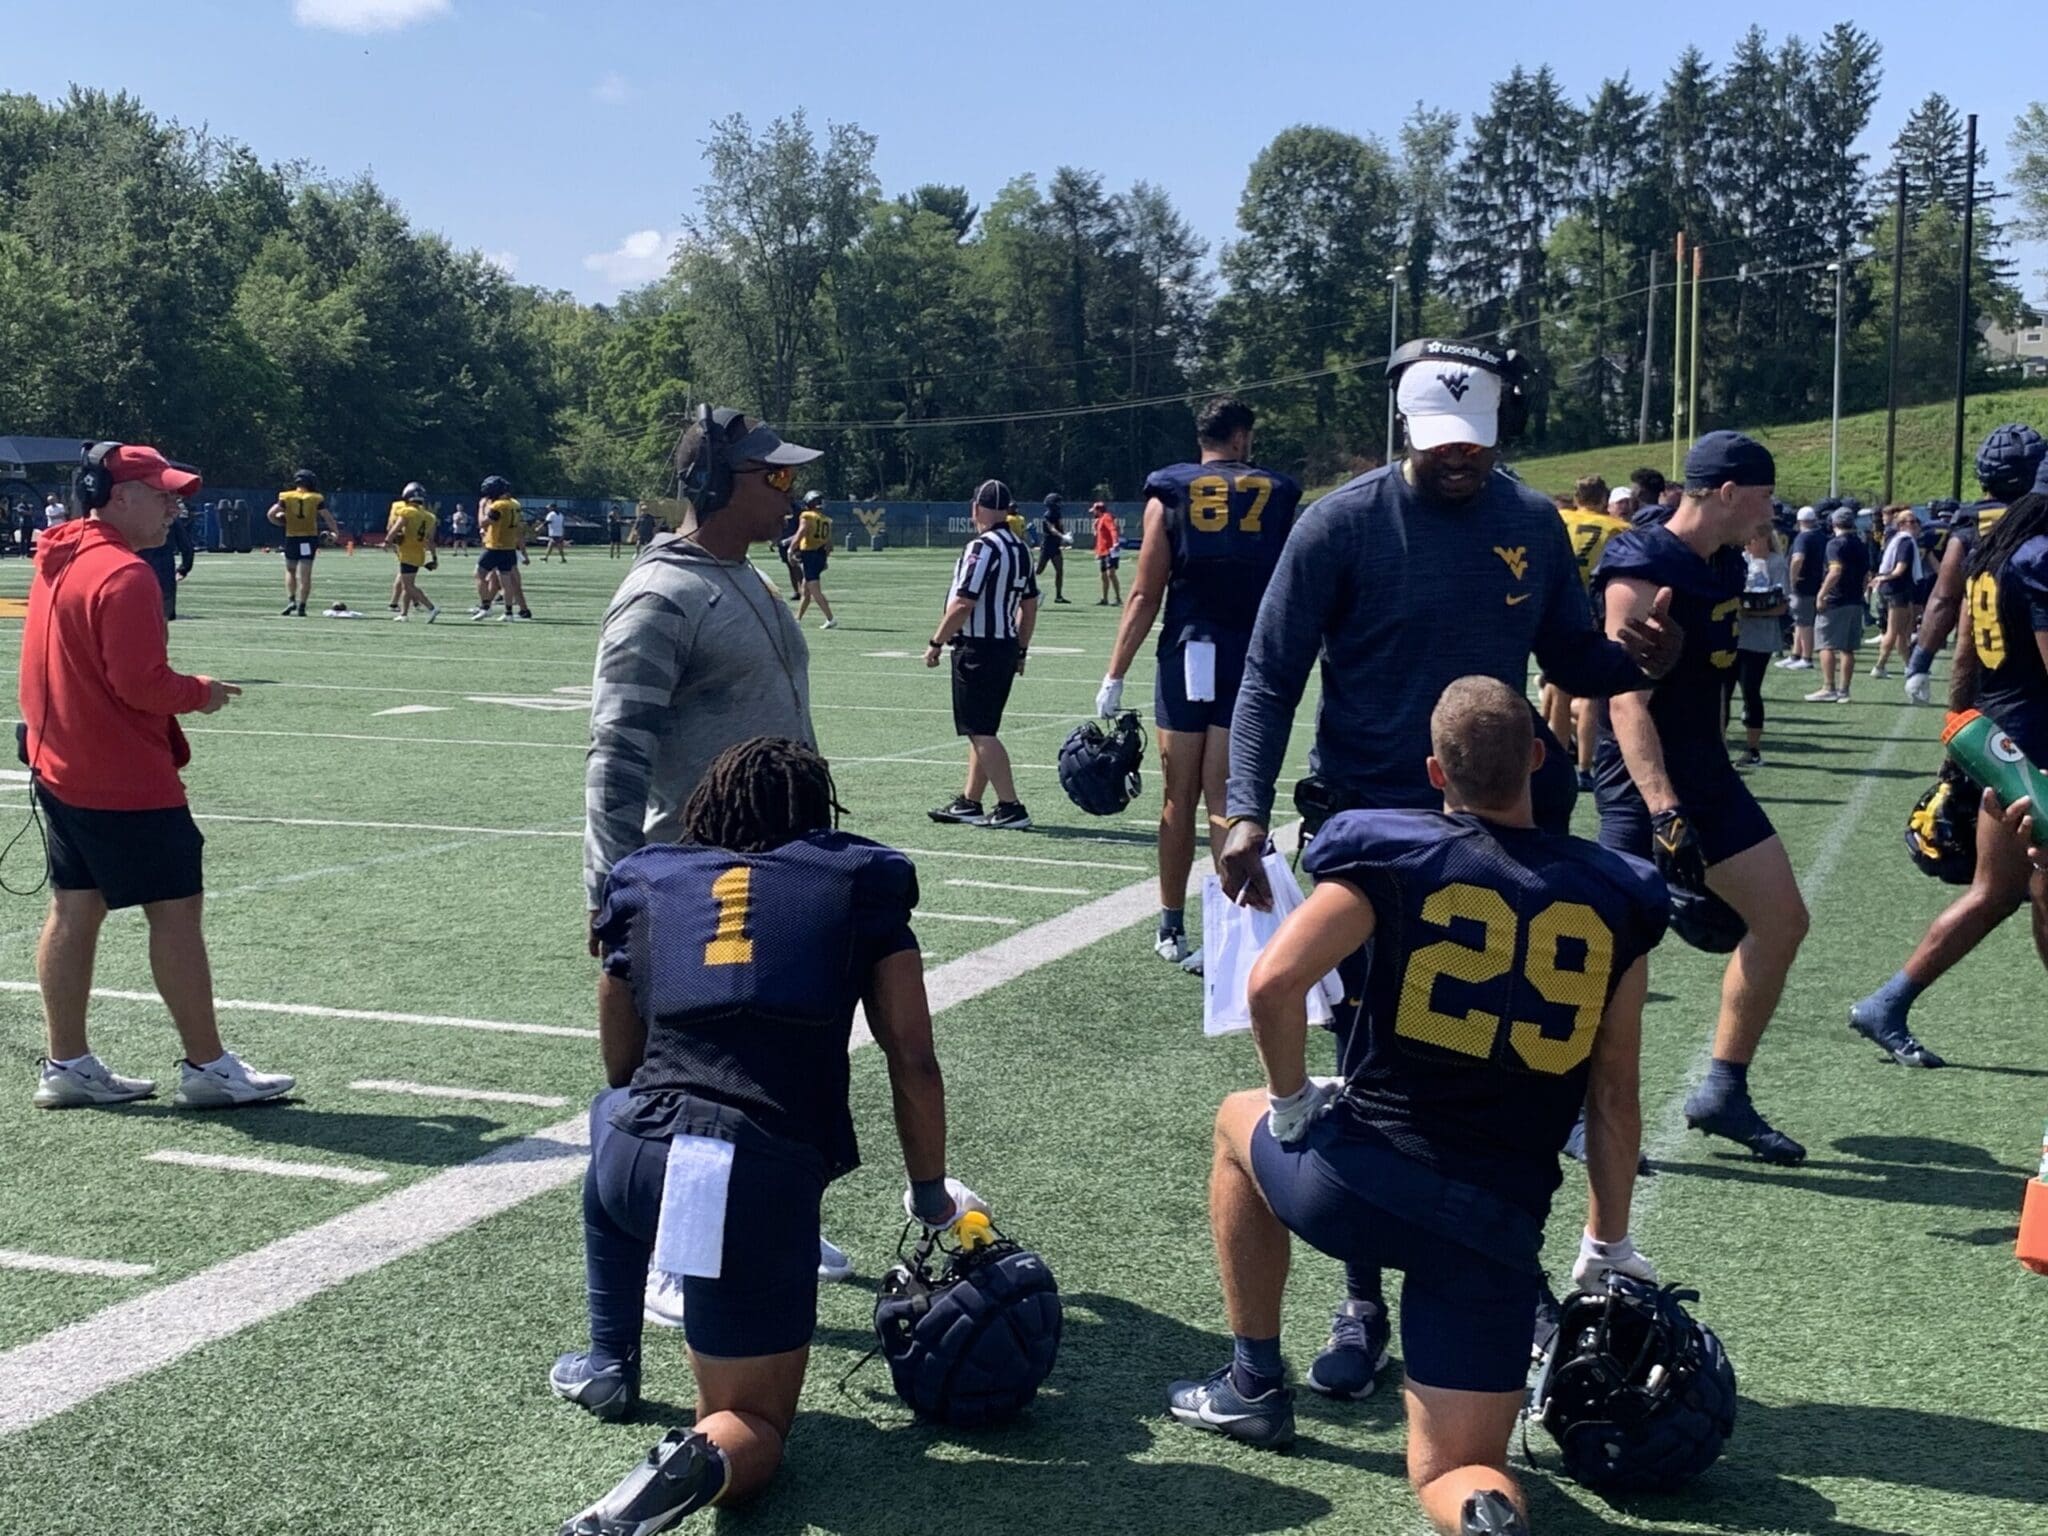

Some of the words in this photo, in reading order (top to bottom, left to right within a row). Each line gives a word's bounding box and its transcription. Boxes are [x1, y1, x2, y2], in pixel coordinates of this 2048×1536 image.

[1189, 475, 1272, 533] 87
[704, 867, 754, 966] 1
[1395, 882, 1613, 1075] 29
